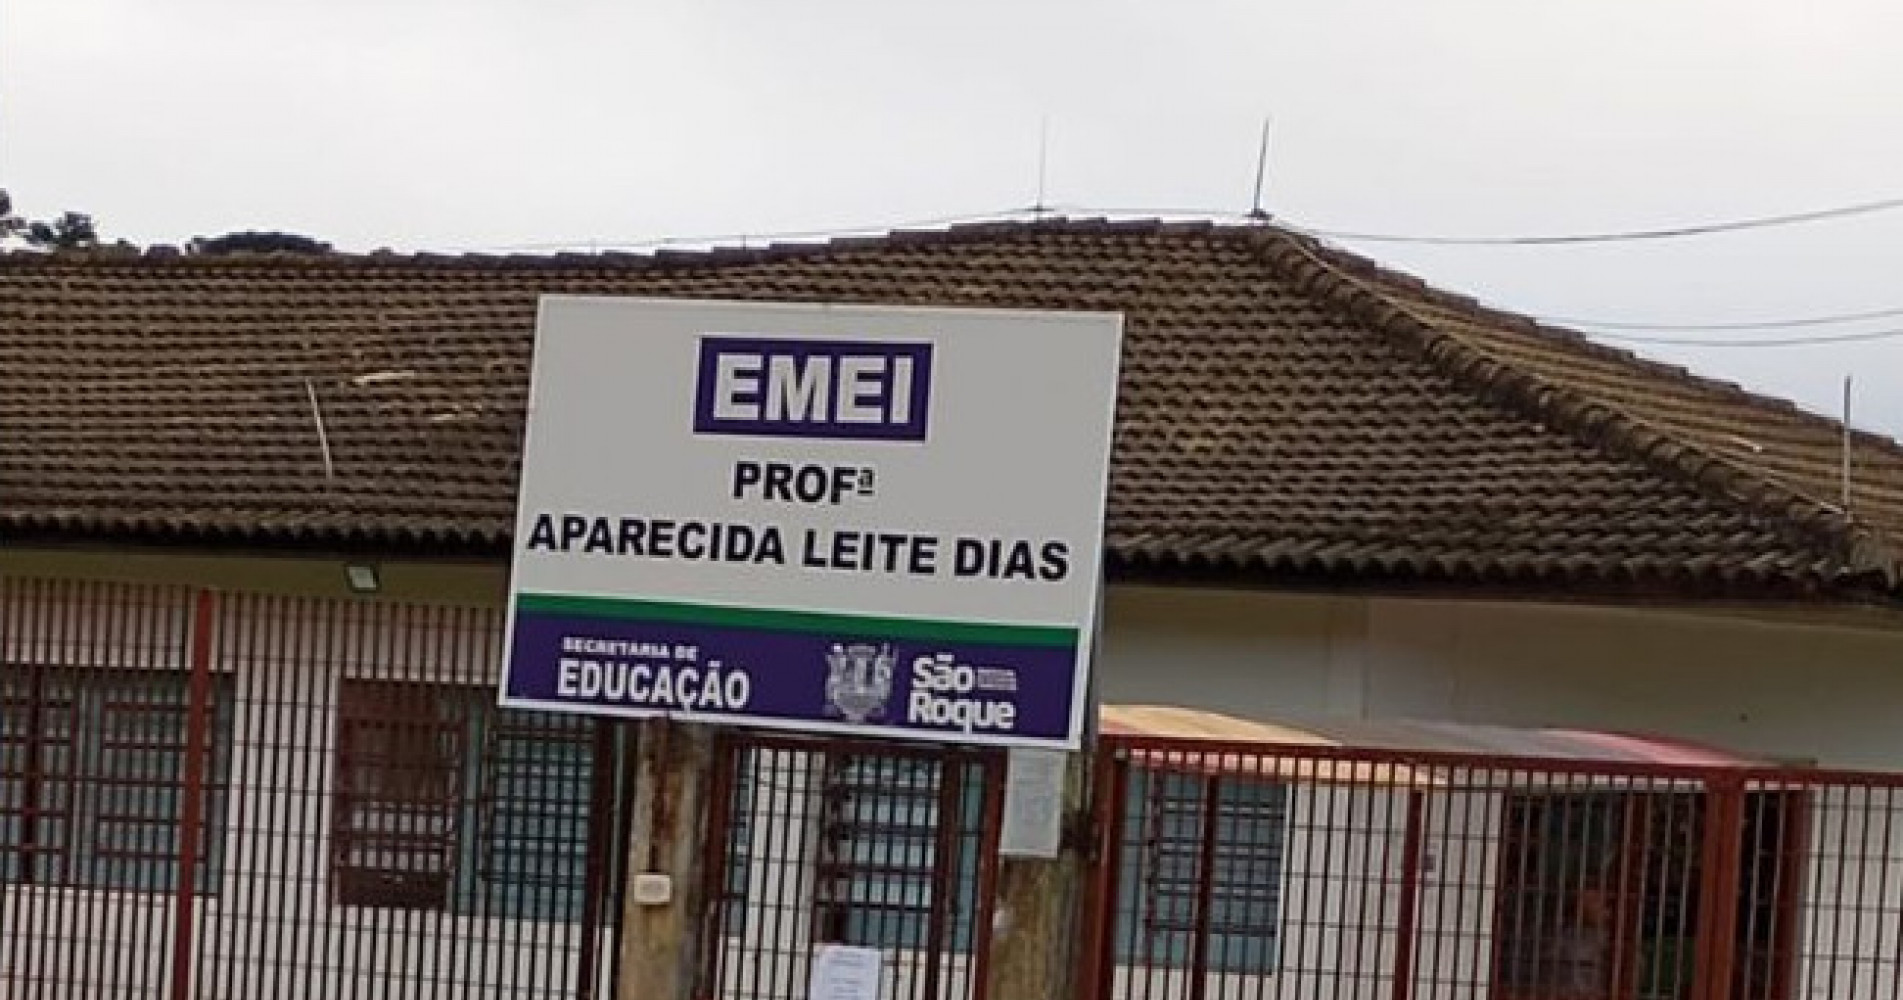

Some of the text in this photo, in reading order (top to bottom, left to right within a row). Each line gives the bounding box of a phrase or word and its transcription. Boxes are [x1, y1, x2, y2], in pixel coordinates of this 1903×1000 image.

[713, 352, 913, 425] EMEI
[733, 462, 876, 506] PROFª
[528, 514, 1070, 582] APARECIDA LEITE DIAS
[563, 637, 699, 661] SECRETARIA DE
[557, 659, 749, 712] EDUCAÇÃO
[911, 653, 974, 692] São
[907, 691, 1017, 734] Roque
